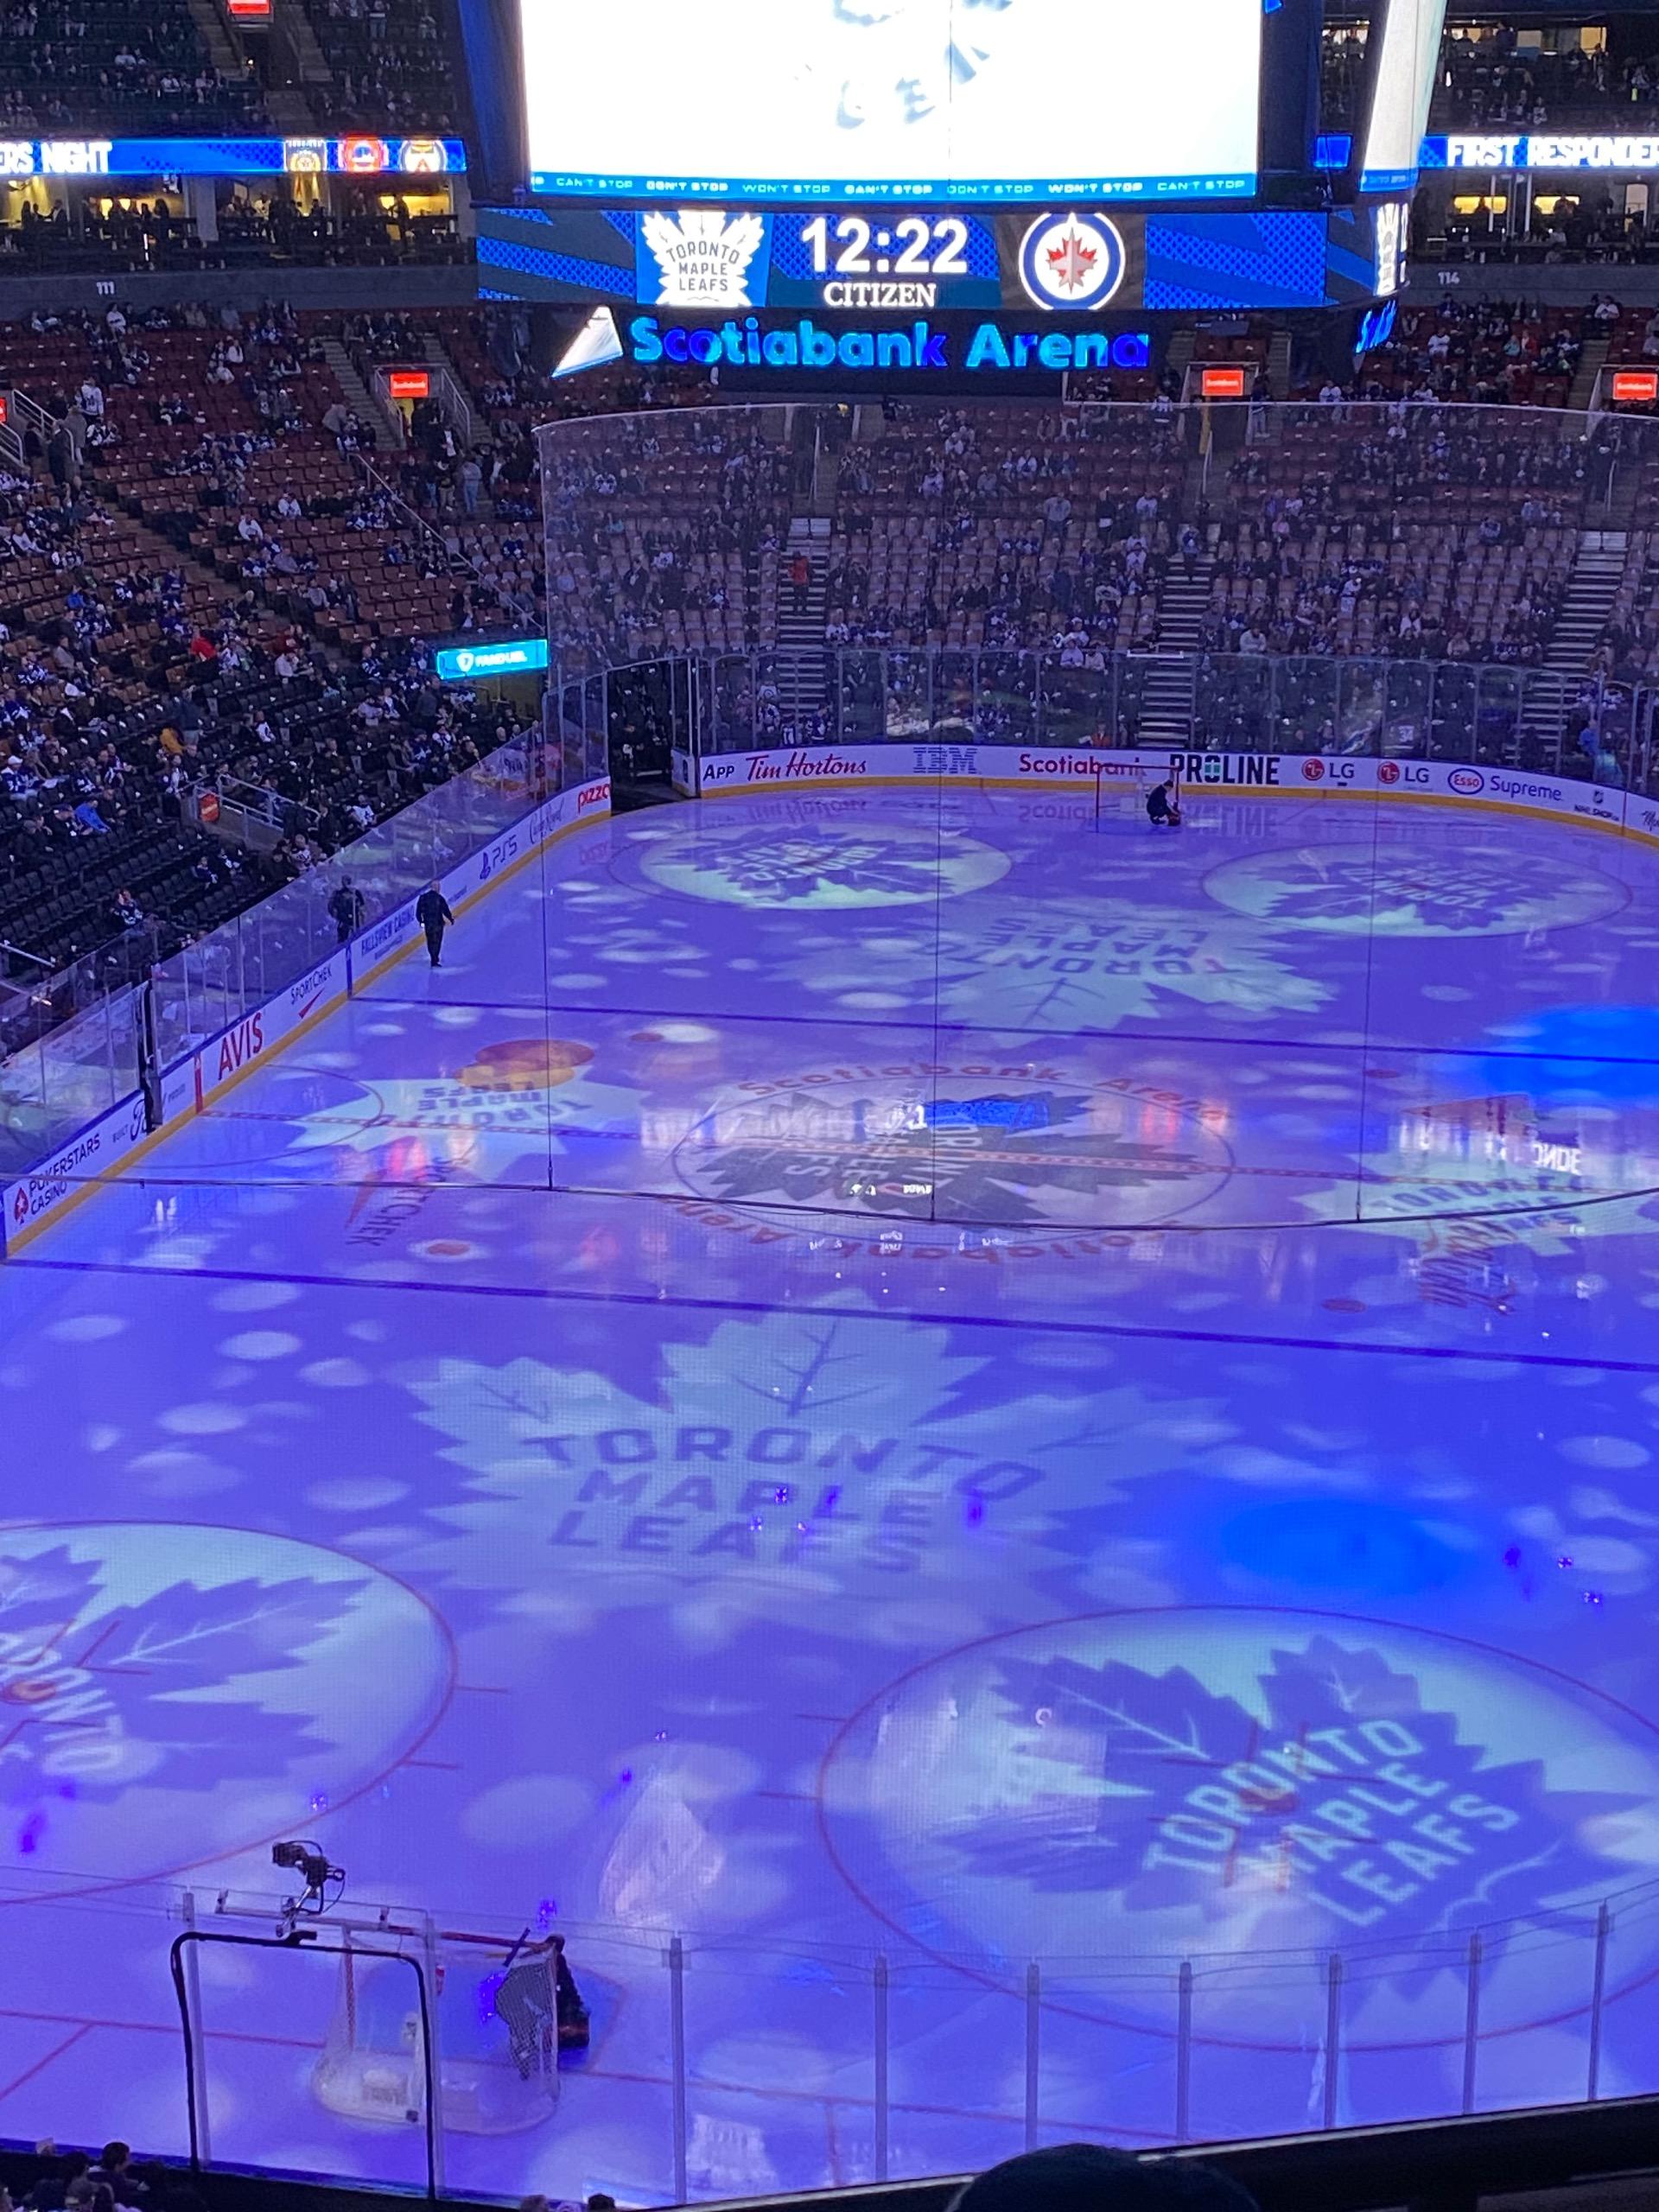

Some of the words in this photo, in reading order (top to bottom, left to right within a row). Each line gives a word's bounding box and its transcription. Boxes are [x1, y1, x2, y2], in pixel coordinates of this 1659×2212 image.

[41, 141, 112, 174] NIGHT
[1447, 136, 1520, 167] FIRST
[665, 240, 741, 264] TORONTO
[802, 216, 968, 274] 12:22
[678, 263, 728, 276] MAPLE
[678, 277, 728, 291] LEAFS
[96, 281, 116, 296] 111
[823, 282, 937, 309] CITIZEN
[630, 316, 949, 369] Scotiabank
[965, 322, 1150, 370] Arena
[746, 754, 781, 782] Tim
[785, 751, 867, 779] Hortons
[912, 747, 978, 775] IBM
[1169, 753, 1281, 785] PROLINE
[1328, 762, 1355, 779] LG
[1404, 766, 1430, 783] LG
[1490, 775, 1563, 802] Supreme
[977, 932, 1199, 959] MAPLE
[218, 1011, 264, 1081] AVIS
[738, 1061, 1069, 1096] Scotiabank
[519, 1426, 1046, 1503] TORONTO
[574, 1468, 945, 1529] MAPLE
[549, 1510, 930, 1573] LEAFS
[1141, 1718, 1426, 1876] TORONTO
[1307, 1793, 1520, 1927] LEAFS
